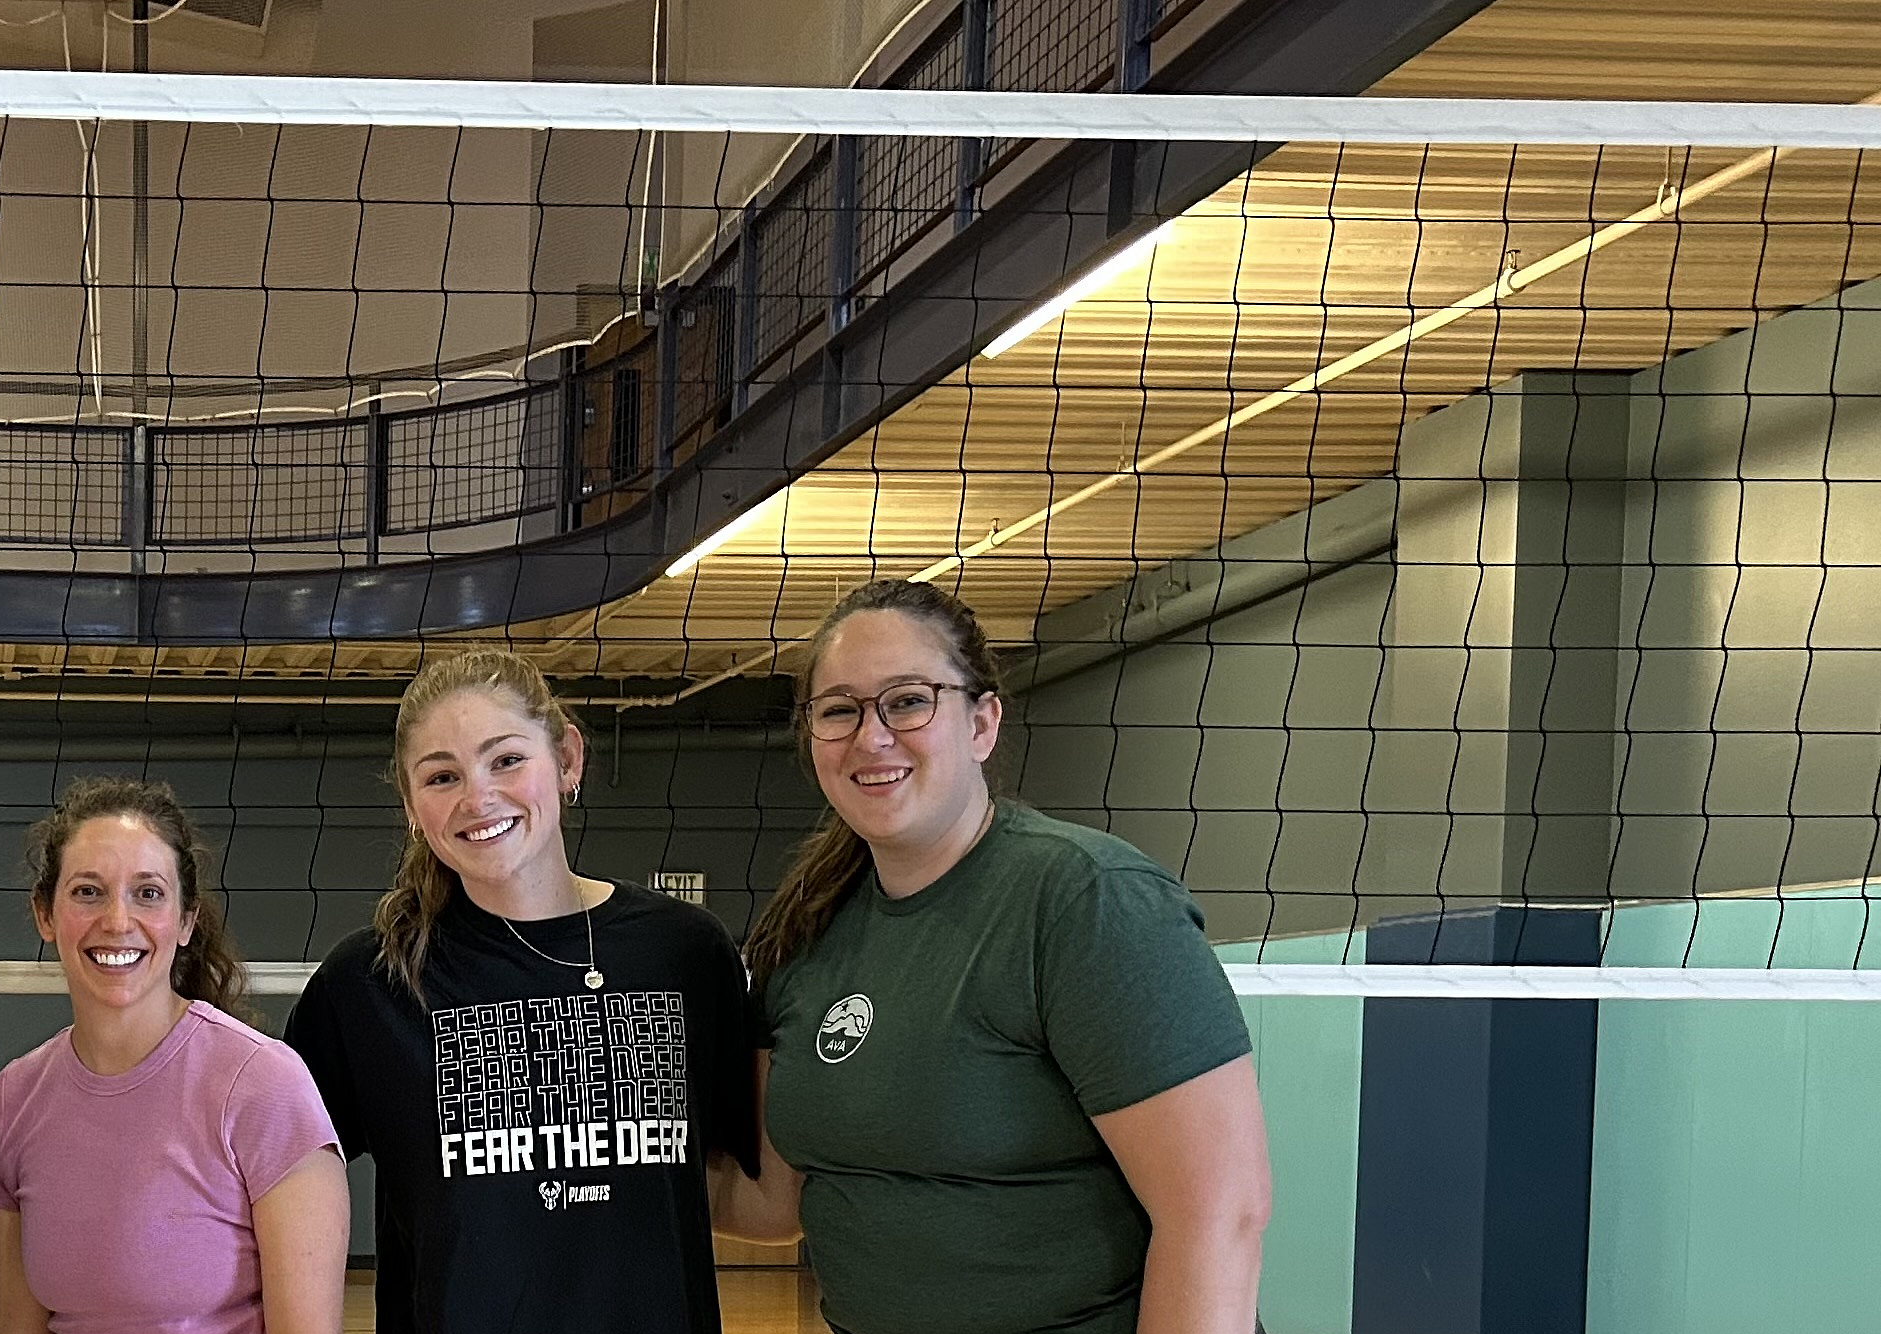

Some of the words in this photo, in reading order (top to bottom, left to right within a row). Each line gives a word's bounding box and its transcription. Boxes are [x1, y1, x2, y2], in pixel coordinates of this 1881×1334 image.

[825, 1039, 847, 1052] AVA
[436, 1053, 530, 1095] FEAR
[534, 1047, 606, 1084] THE
[437, 1086, 532, 1134] FEAR
[537, 1081, 608, 1124] THE
[613, 1079, 688, 1120] DEER
[440, 1127, 534, 1178] FEAR
[539, 1122, 610, 1169] THE
[616, 1120, 688, 1166] DEER
[568, 1184, 611, 1203] PLAYOFFS
